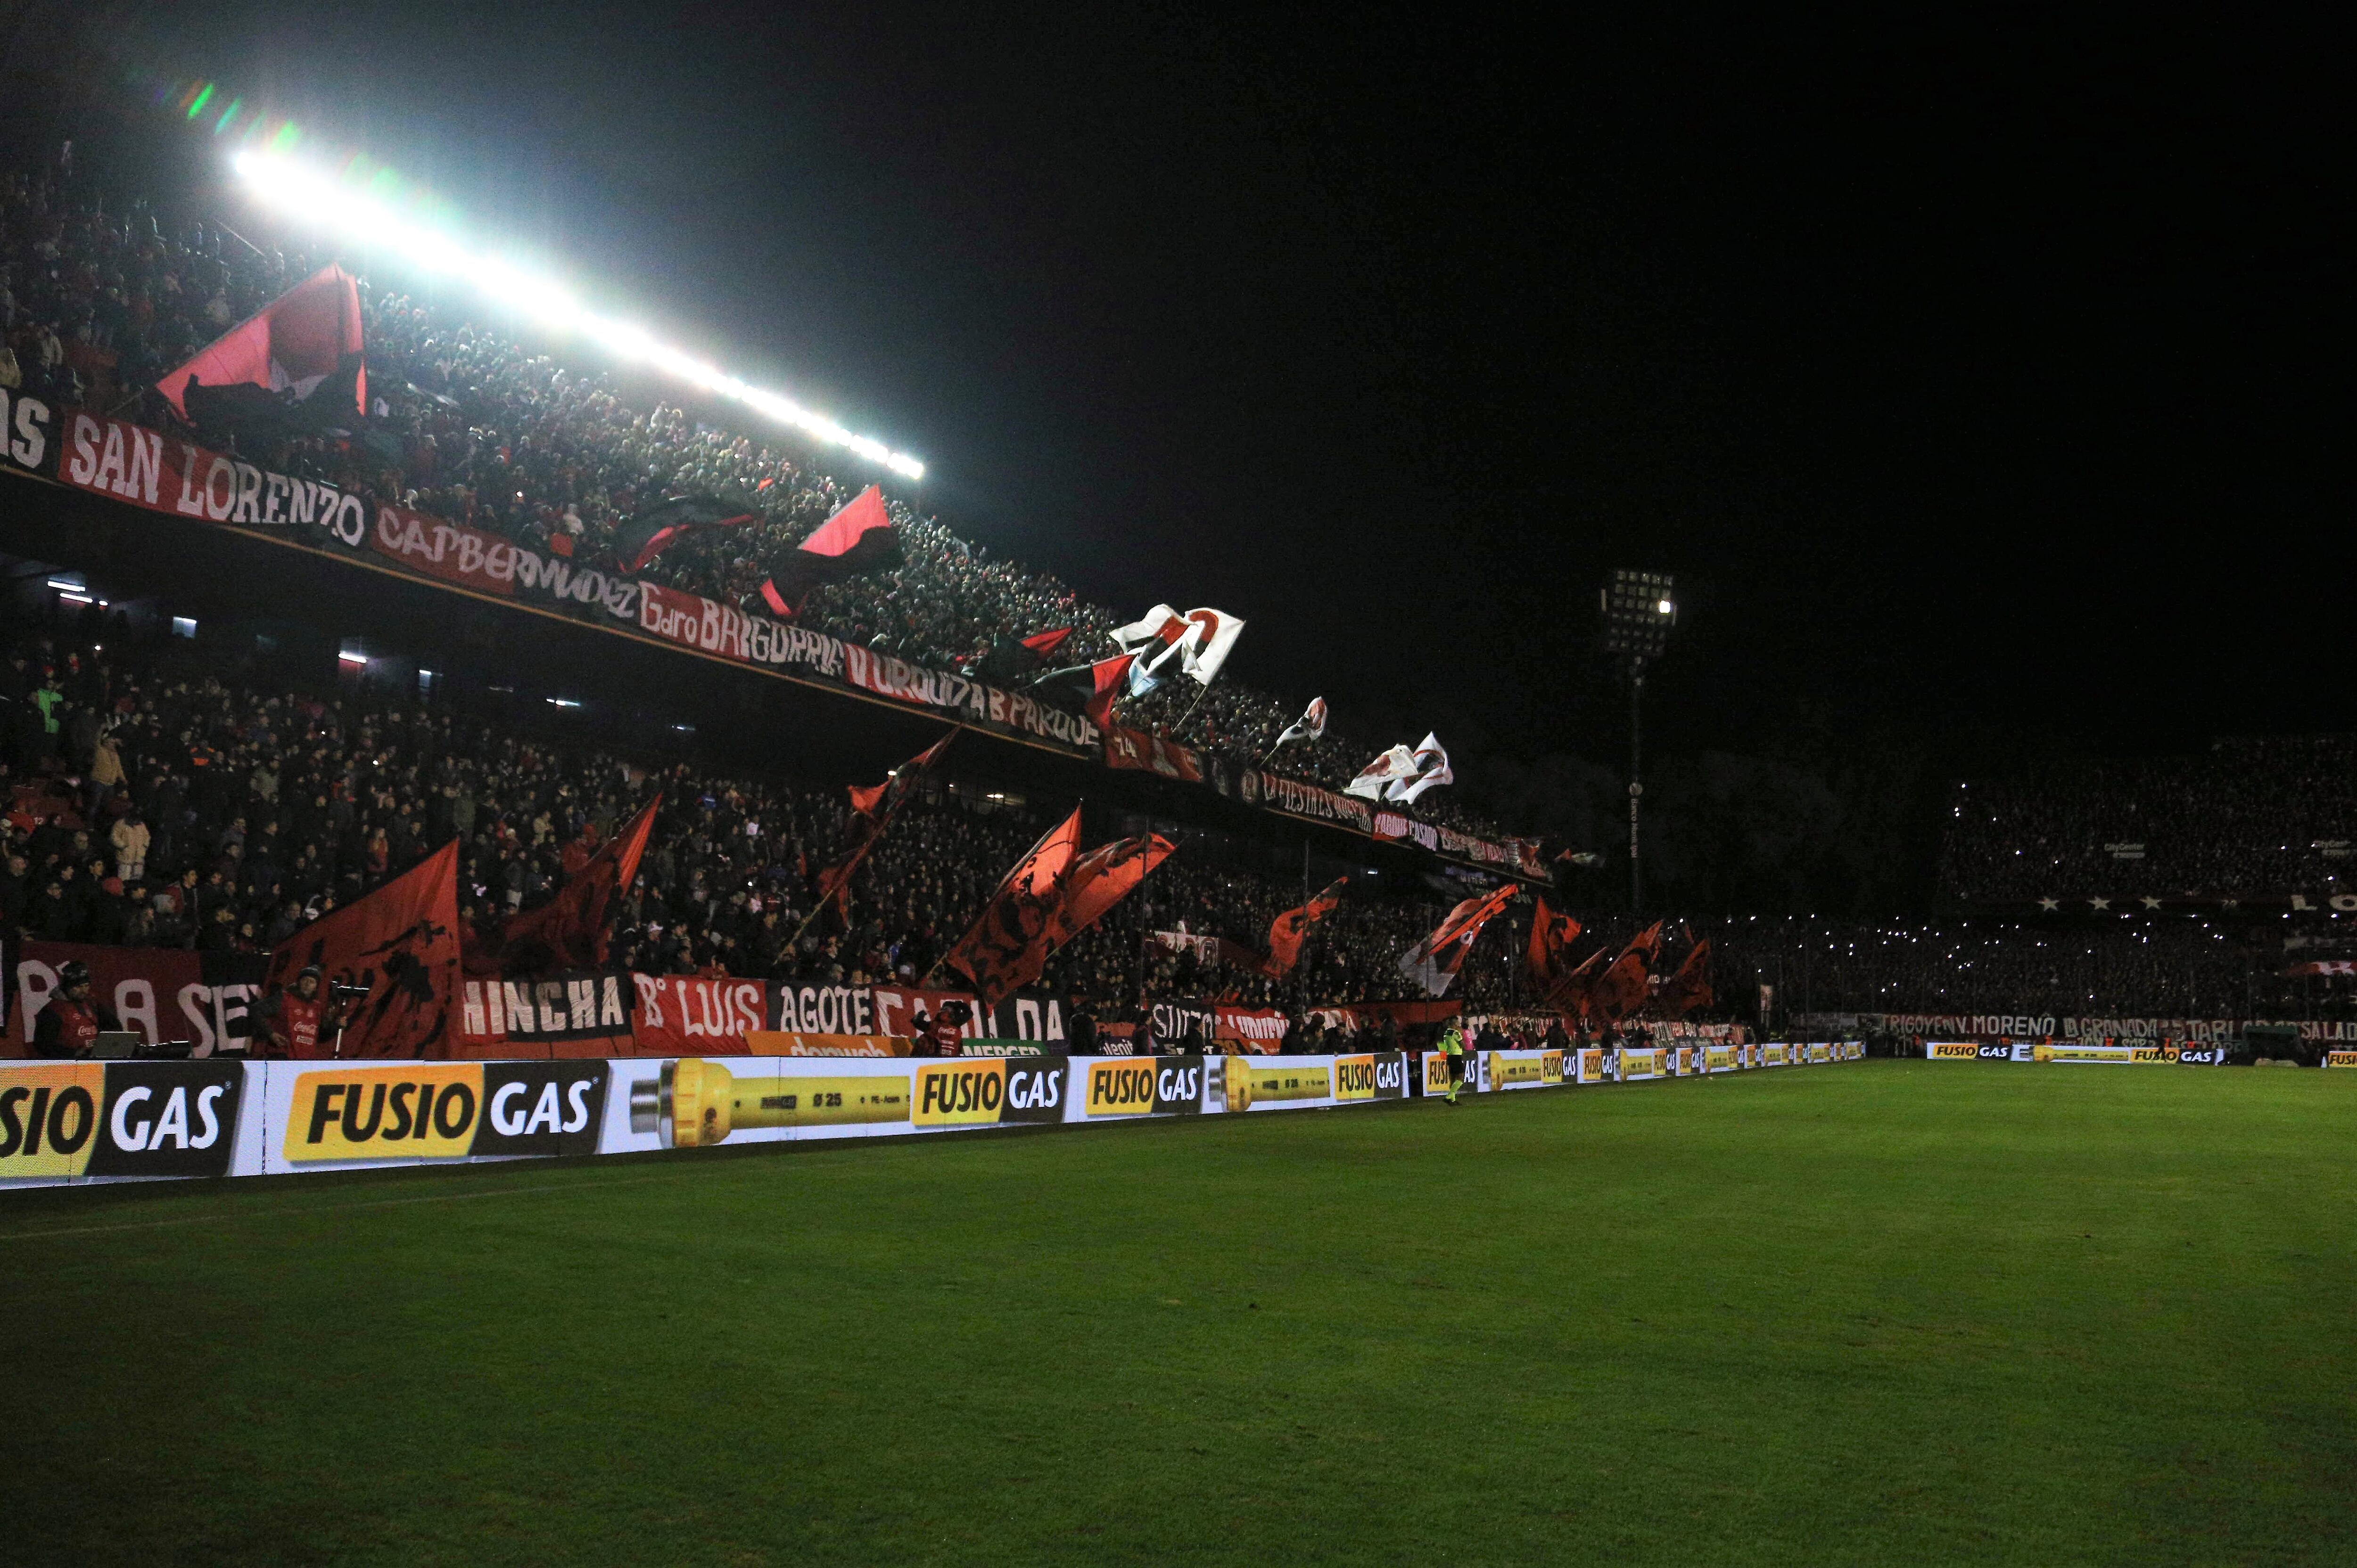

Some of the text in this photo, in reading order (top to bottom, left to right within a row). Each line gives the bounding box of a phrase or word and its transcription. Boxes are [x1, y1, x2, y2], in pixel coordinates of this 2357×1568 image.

[70, 414, 364, 546] SAN LORENZO
[872, 654, 984, 720] URQUIZA
[1011, 693, 1099, 745] PARQUE
[463, 977, 624, 1034] HINCHA
[676, 980, 759, 1037] LUIS
[780, 985, 872, 1035] AGOTE
[1972, 1015, 2055, 1036] MORENO
[2081, 1018, 2158, 1038] GRANADA
[1543, 1055, 1576, 1077] FUSIO GAS
[1584, 1055, 1613, 1075] FUSIO GAS
[1666, 1054, 1675, 1070] GAS
[1937, 1046, 2008, 1057] FUSIO GAS
[2181, 1051, 2212, 1062] GAS
[922, 1070, 1060, 1114] FUSIO GAS
[1093, 1067, 1197, 1105] FUSIO GAS
[1338, 1062, 1400, 1092] FUSIO GAS
[307, 1081, 591, 1143] FUSIO GAS
[826, 1093, 841, 1106] 25
[111, 1085, 223, 1151] GAS
